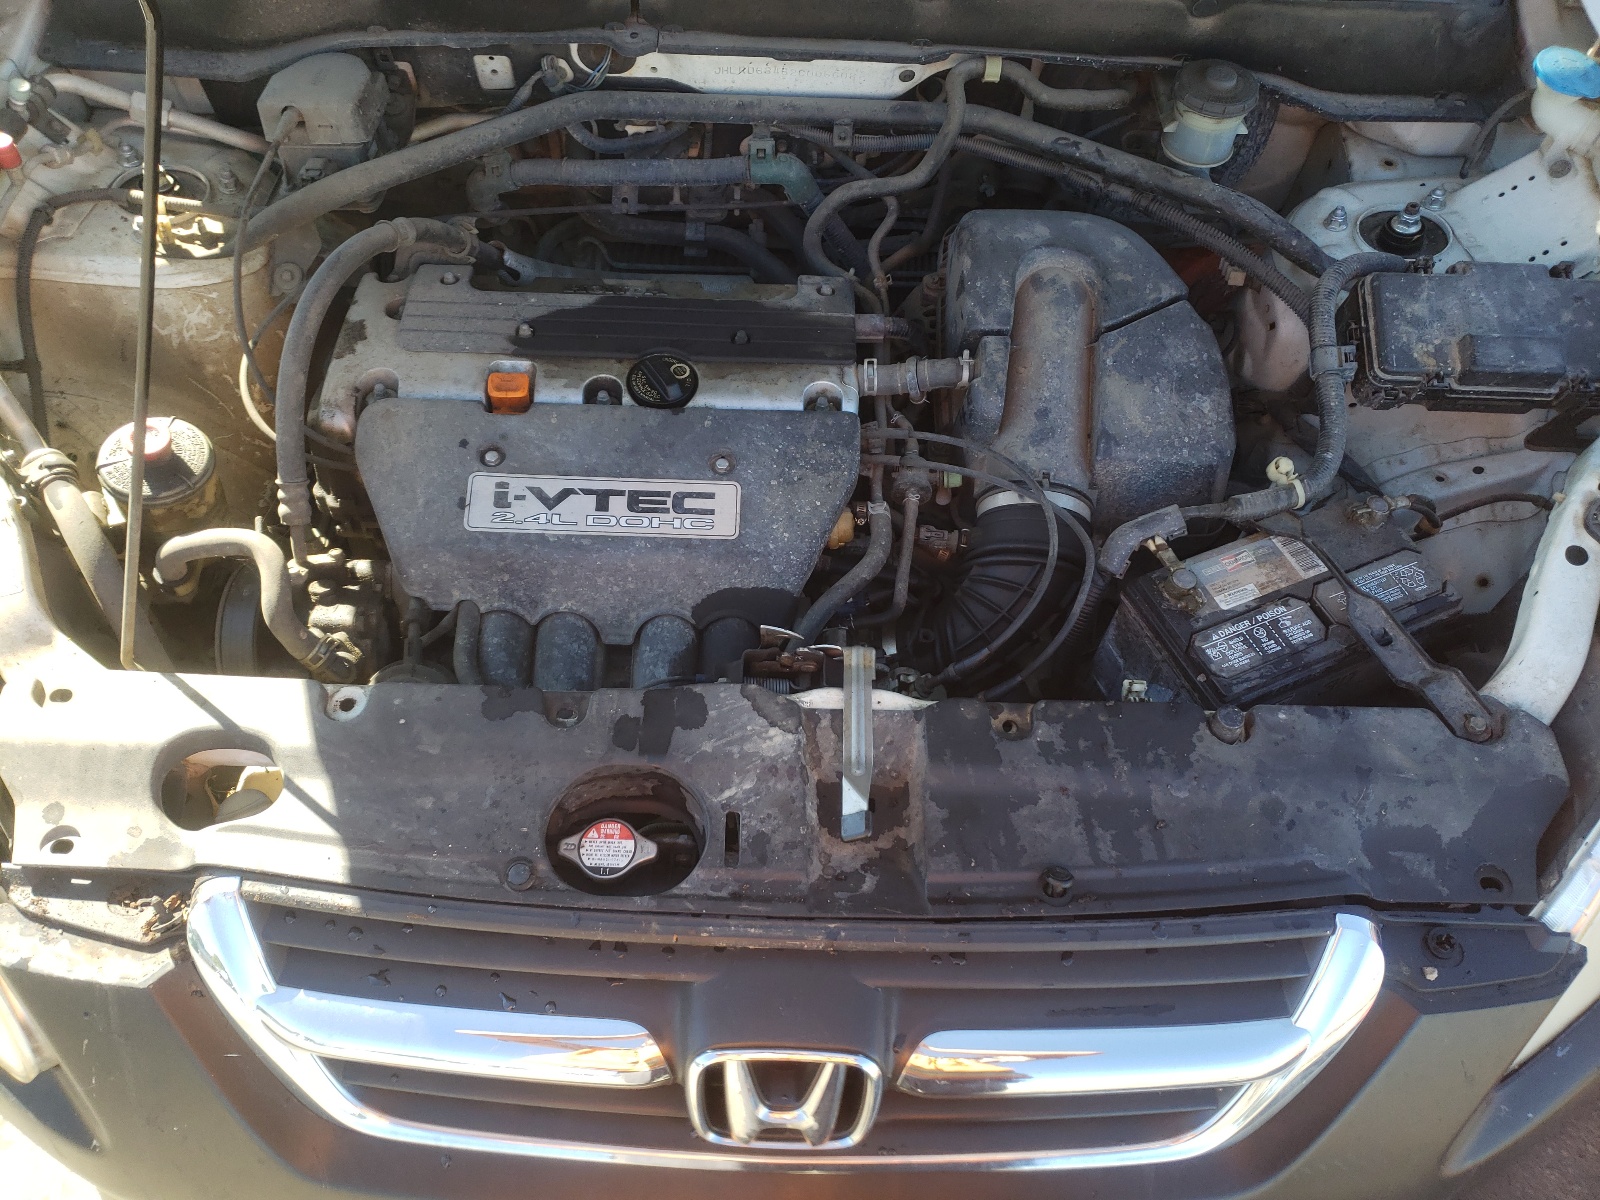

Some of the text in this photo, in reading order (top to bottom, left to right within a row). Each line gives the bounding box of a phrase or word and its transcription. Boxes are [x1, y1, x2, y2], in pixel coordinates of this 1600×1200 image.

[493, 481, 716, 515] i-VTEC
[491, 511, 715, 530] 2.4L DOHC
[1218, 619, 1252, 638] DANGER
[1256, 605, 1288, 622] POISON
